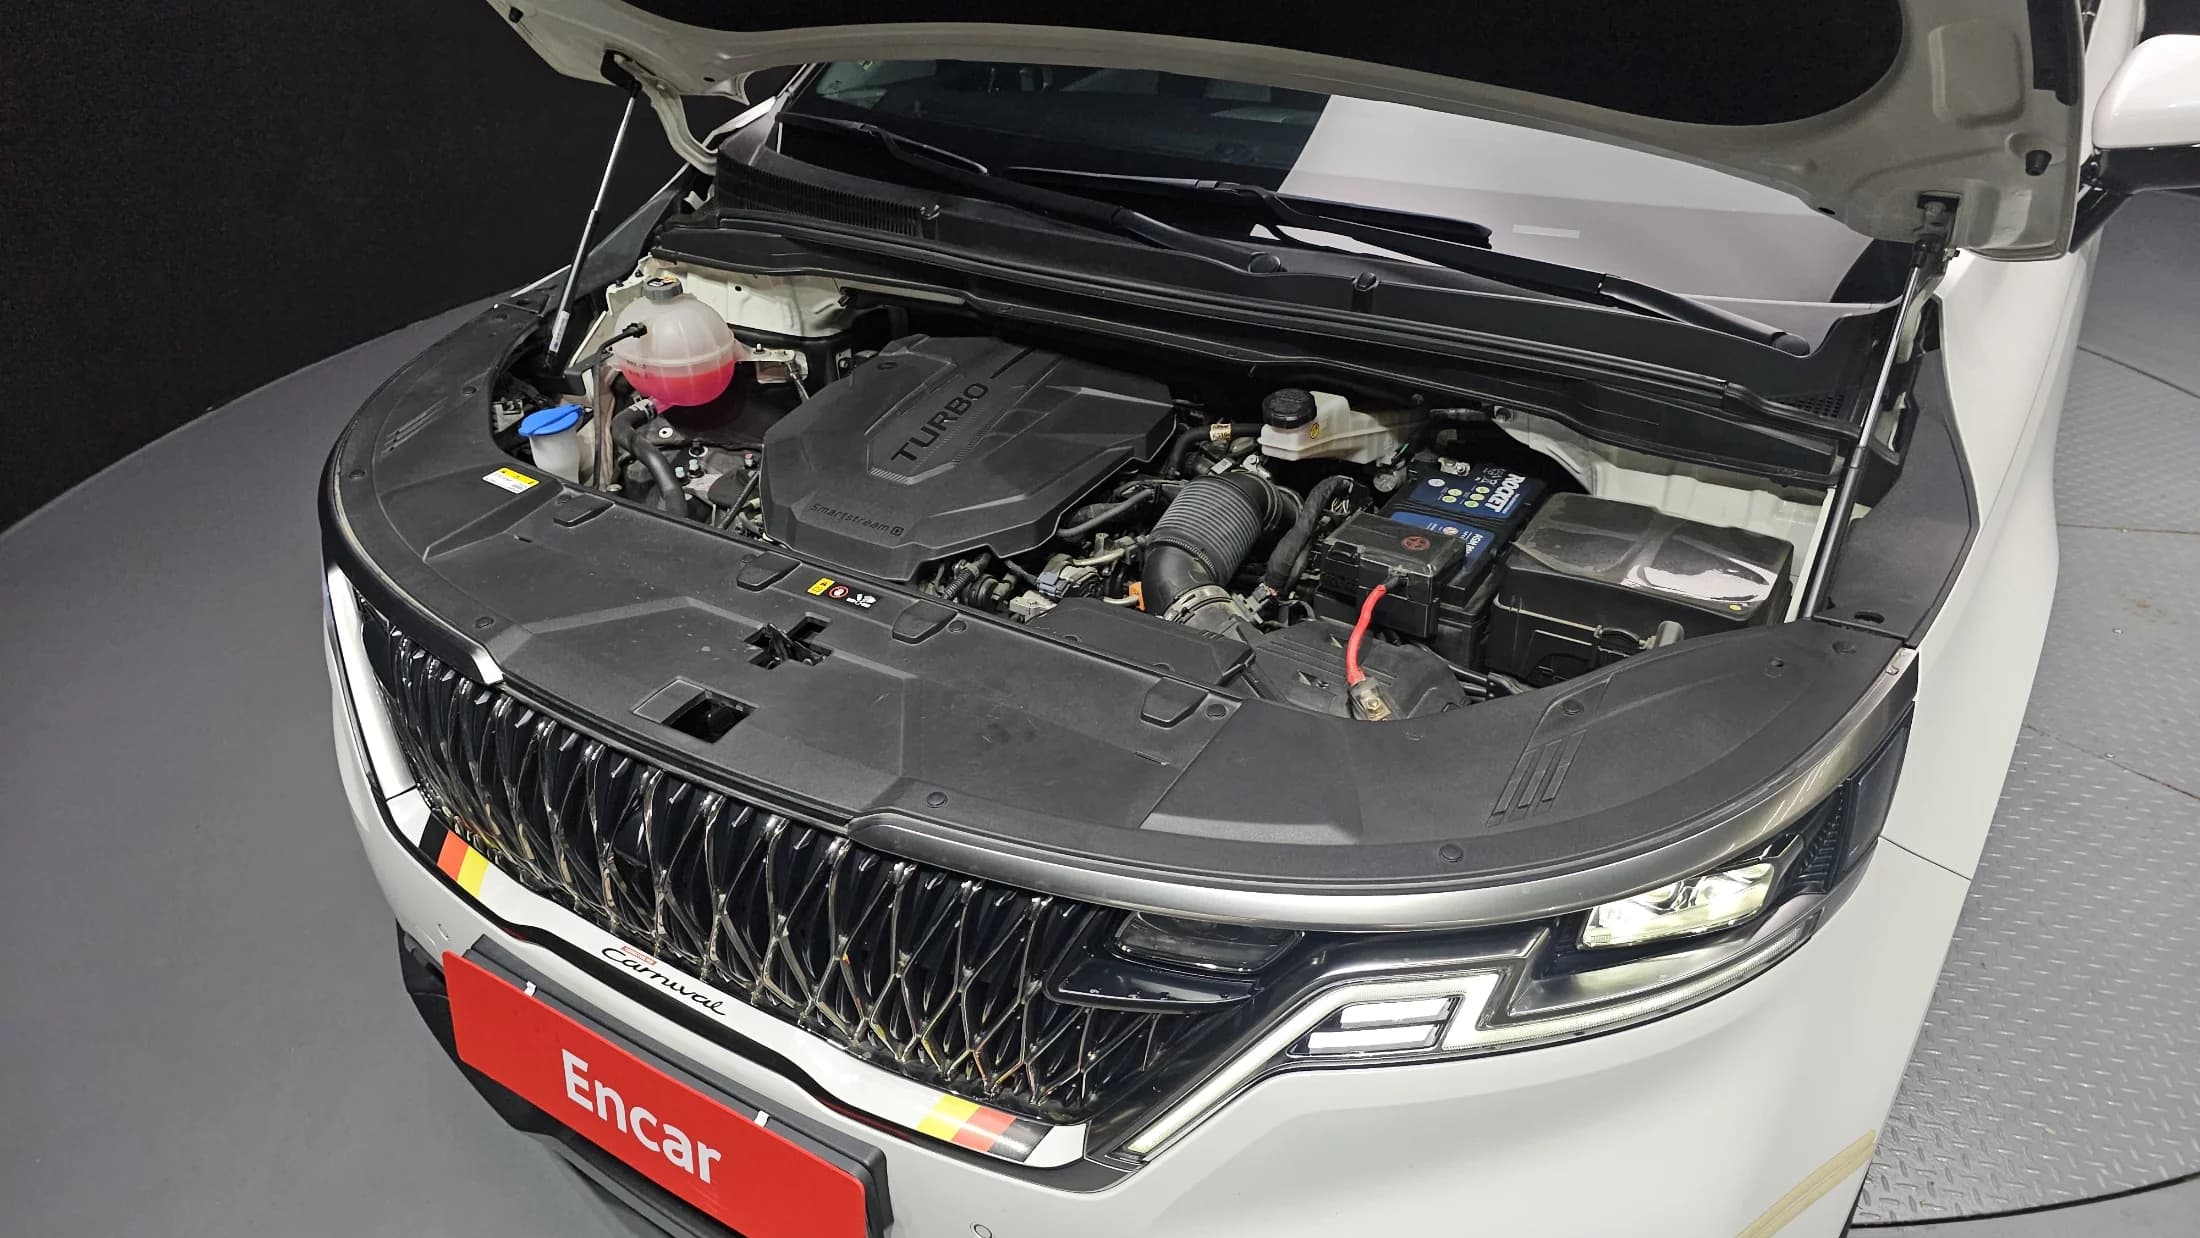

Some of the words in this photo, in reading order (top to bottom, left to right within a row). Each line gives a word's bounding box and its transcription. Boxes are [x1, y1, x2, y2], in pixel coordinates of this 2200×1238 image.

[890, 383, 988, 461] TURBO
[1485, 473, 1526, 512] ROCKET
[601, 948, 726, 1015] Carnival
[562, 1049, 722, 1184] Encar
